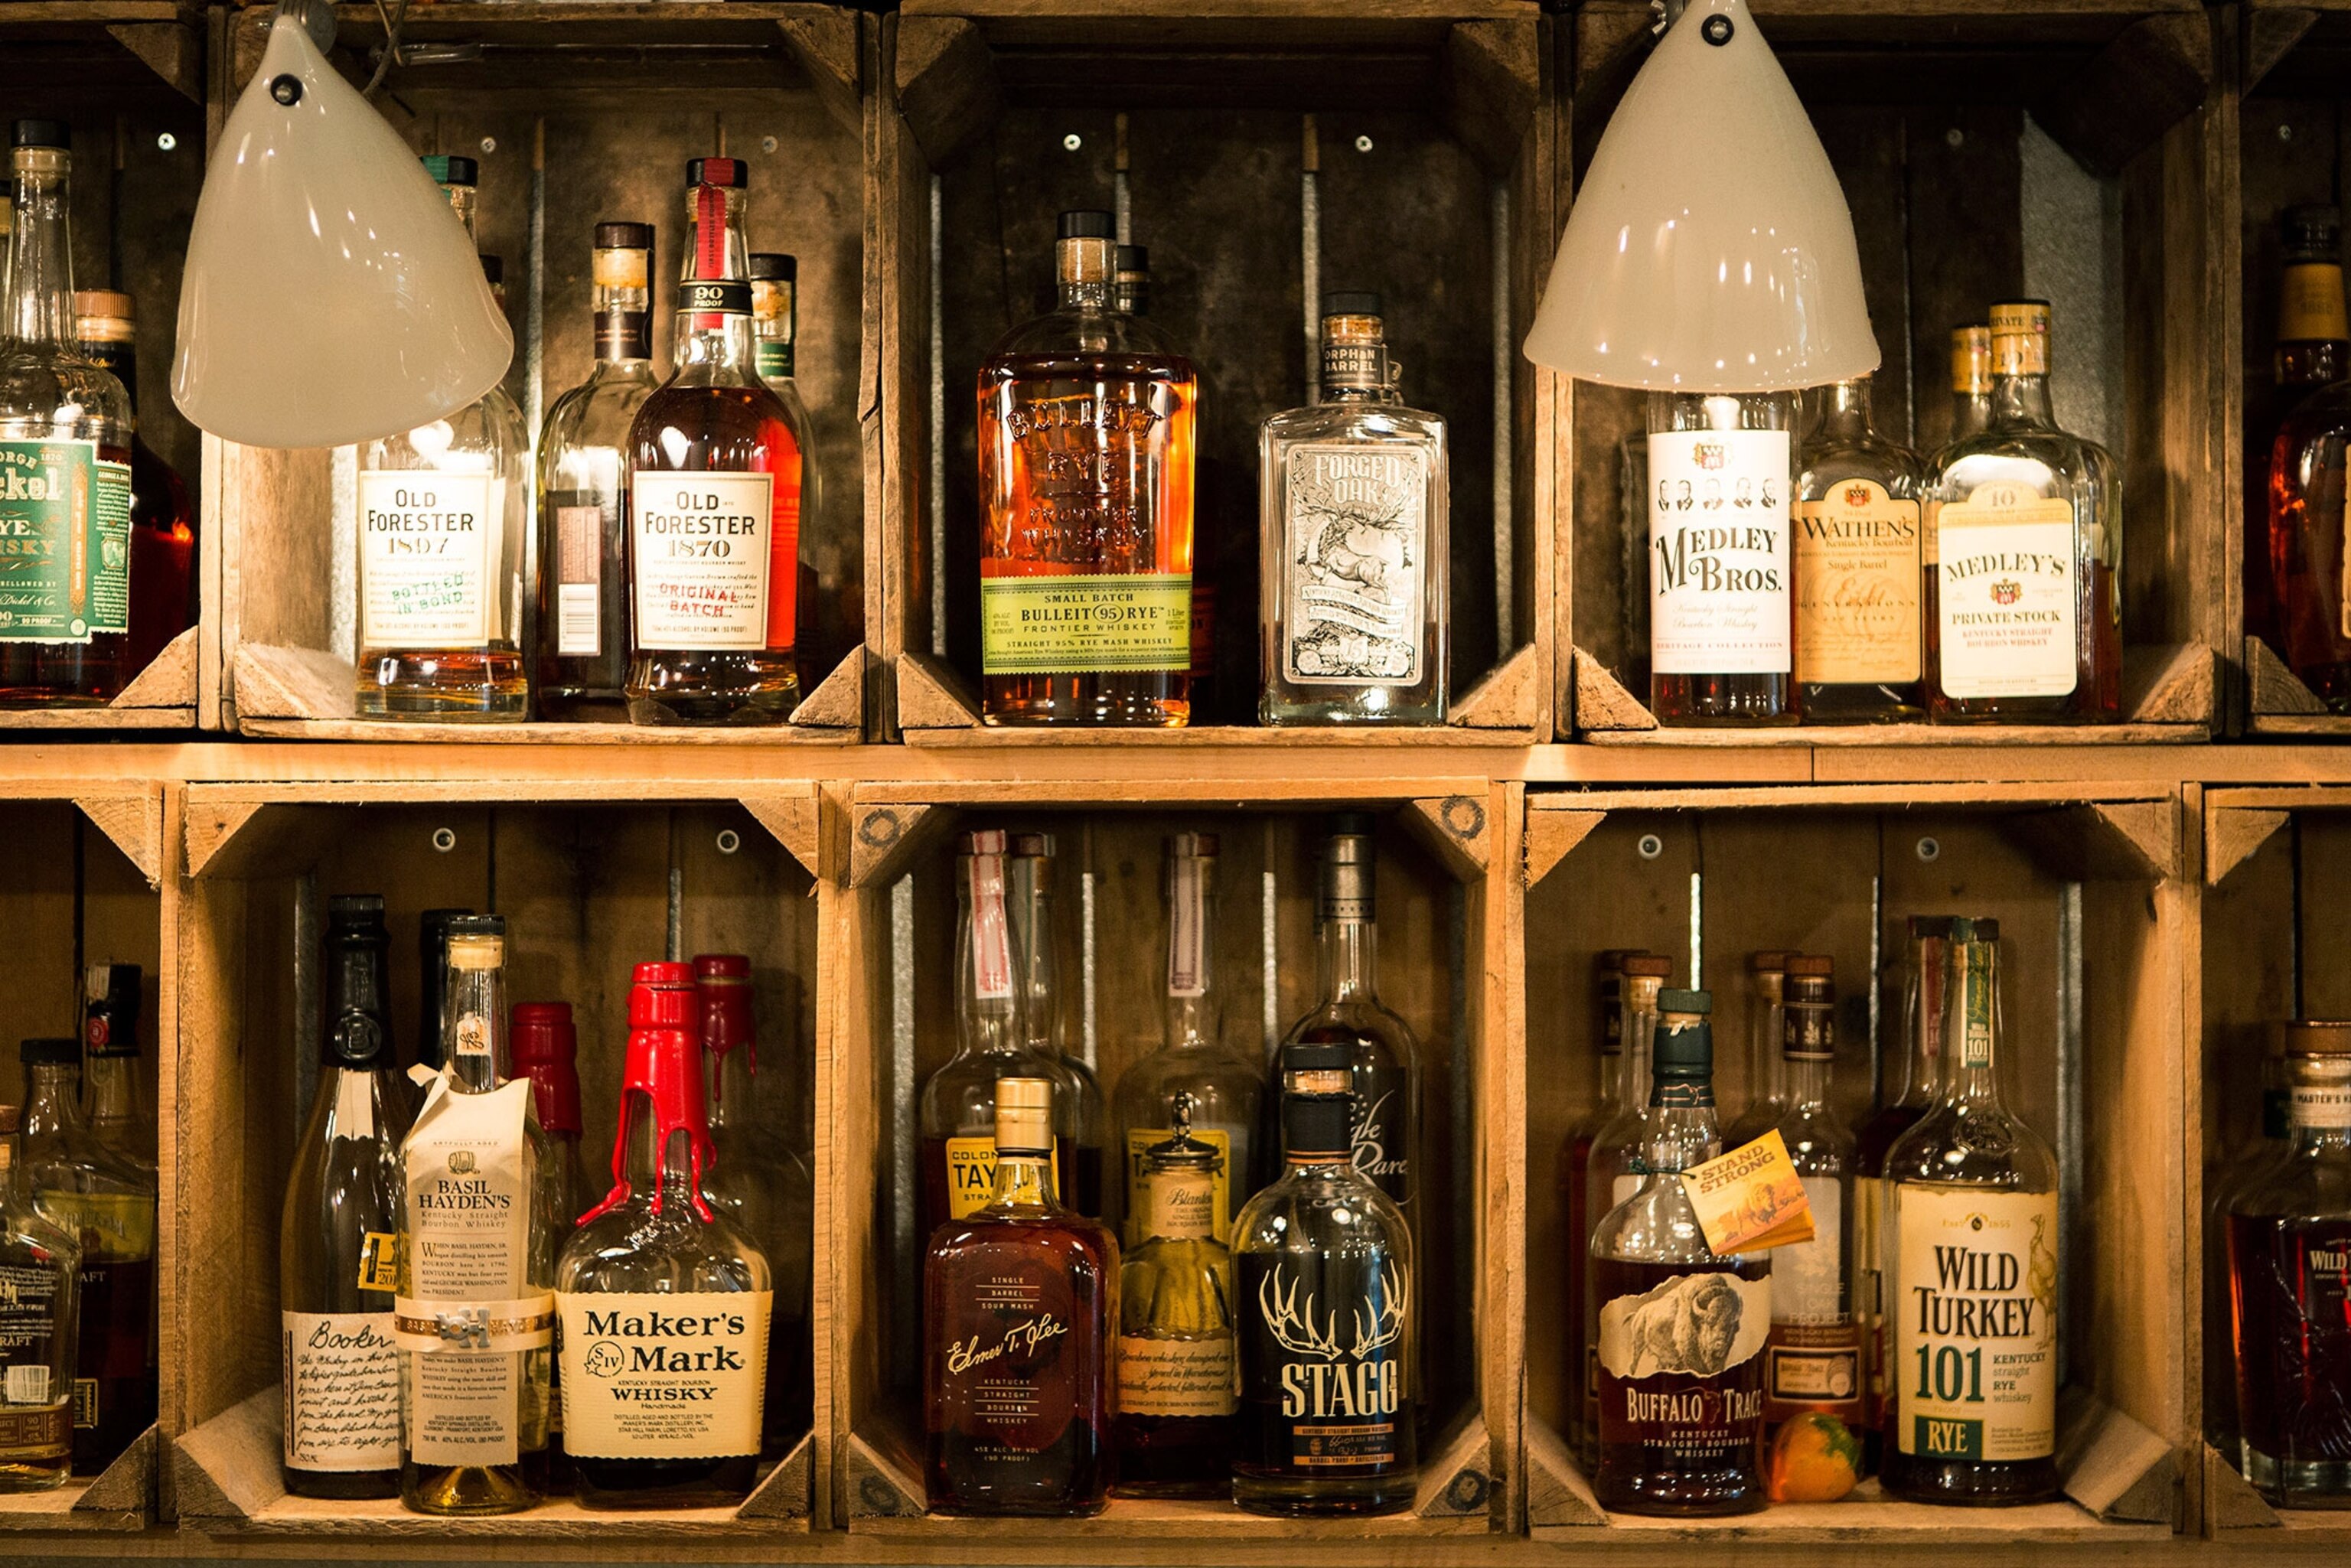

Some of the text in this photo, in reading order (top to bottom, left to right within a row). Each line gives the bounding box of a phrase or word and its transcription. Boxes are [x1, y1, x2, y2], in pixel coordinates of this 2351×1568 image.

[695, 286, 723, 299] 90
[1325, 349, 1375, 360] ORPHAN
[1325, 360, 1377, 372] BARREL
[1048, 449, 1119, 483] RYE
[1315, 454, 1400, 487] FORGED
[396, 489, 436, 507] OLD
[677, 491, 719, 510] OLD
[1334, 479, 1378, 504] OAK
[1991, 491, 2016, 507] 10
[368, 510, 474, 532] FORESTER
[645, 512, 755, 535] FORESTER
[1802, 516, 1915, 540] WATHEN'S
[668, 540, 731, 558] 1870
[1826, 537, 1913, 548] Kentucky Bourbon
[1656, 526, 1778, 596] MEDLEY
[1828, 559, 1887, 572] Single Barrel
[1945, 552, 2066, 582] MEDLEY'S
[1688, 556, 1783, 592] BROS.
[391, 573, 463, 601] BOTTLED
[660, 582, 738, 603] ORIGINAL
[398, 590, 463, 615] IN BOND
[1045, 593, 1134, 604] SMALL BATCH
[670, 600, 725, 617] BATCH
[1021, 607, 1091, 621] BULLEIT
[1100, 608, 1117, 620] 95
[1952, 610, 2061, 626] PRIVATE STOCK
[1023, 623, 1156, 633] FRONTIER WHISKEY
[1962, 628, 2053, 638] KENTUCKY STRAIGHT
[1967, 637, 2048, 648] BOURBON WHISKEY
[1968, 1039, 1988, 1056] 101
[2297, 1094, 2340, 1103] MASTER'S
[1701, 1145, 1765, 1181] STAND
[1700, 1151, 1775, 1194] STRONG
[438, 1180, 491, 1195] BASIL
[419, 1195, 511, 1209] HAYDEN'S
[422, 1211, 508, 1219] Kentucky Straight
[1934, 1245, 2019, 1292] WILD
[2310, 1250, 2347, 1270] WILD
[1913, 1286, 2036, 1339] TURKEY
[583, 1311, 745, 1337] Maker's
[595, 1348, 620, 1368] S IV
[629, 1346, 743, 1373] Mark
[1993, 1353, 2046, 1364] KENTUCKY
[1916, 1343, 1985, 1402] 101
[1993, 1367, 2030, 1377] straight
[611, 1387, 718, 1401] WHISKY
[1282, 1359, 1398, 1417] STAGG
[1993, 1381, 2016, 1390] RYE
[1626, 1387, 1703, 1423] BUFFALO
[1993, 1393, 2033, 1403] whiskey
[1671, 1429, 1730, 1439] KENTUCKY
[1928, 1420, 1968, 1452] RYE
[1644, 1439, 1700, 1448] STRAIGHT
[1675, 1449, 1724, 1457] WHISKEY
